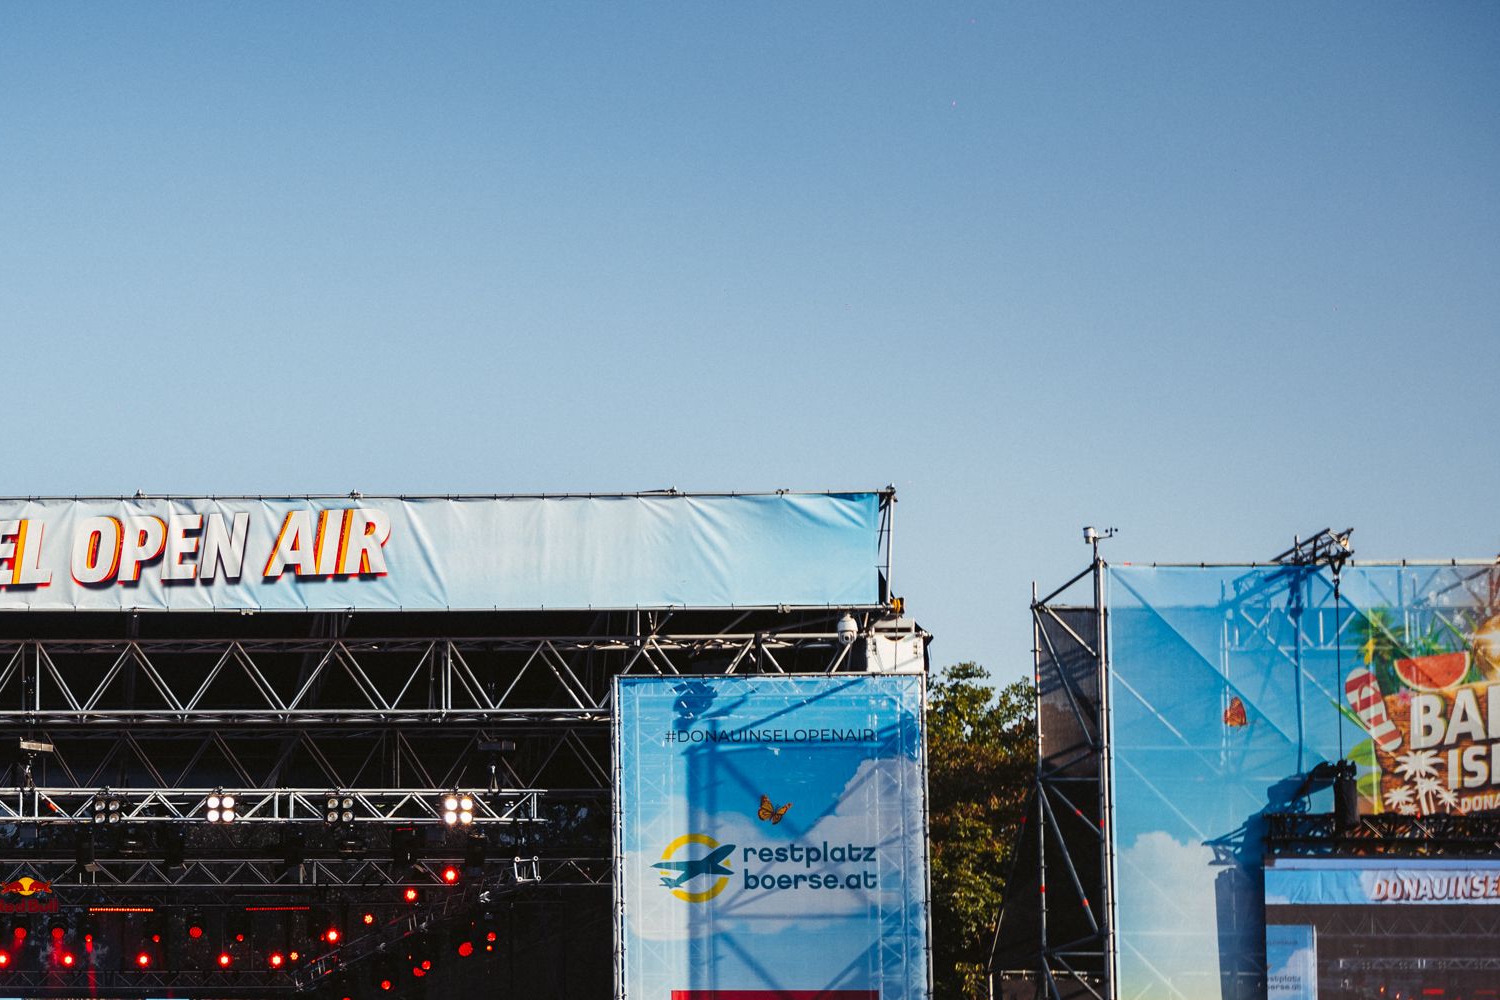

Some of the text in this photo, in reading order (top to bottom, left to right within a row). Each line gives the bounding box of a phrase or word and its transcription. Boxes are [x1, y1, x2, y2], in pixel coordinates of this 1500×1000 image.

[70, 511, 251, 585] OPEN
[263, 507, 392, 579] AIR
[664, 728, 875, 744] #DONAUINSELOPENAIR
[743, 841, 876, 868] restplatz
[744, 869, 877, 890] boerse.at
[28, 895, 59, 913] Bull
